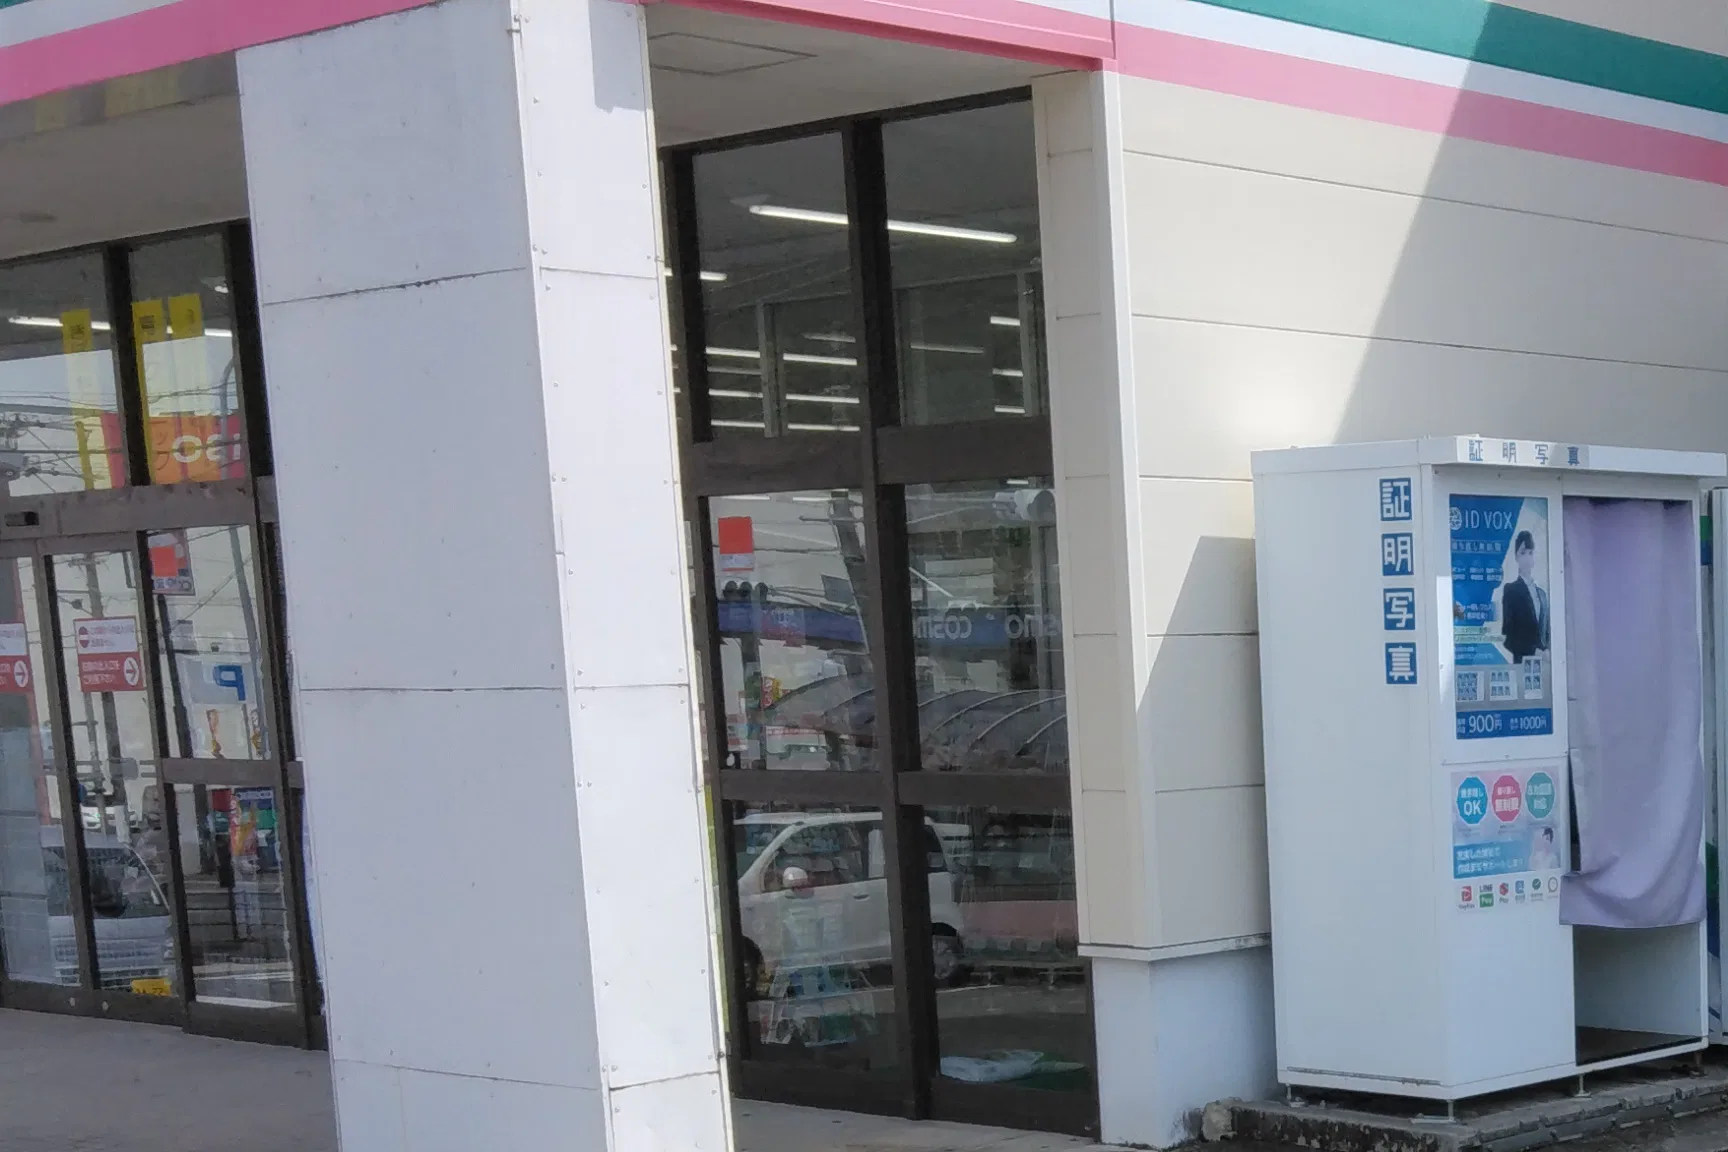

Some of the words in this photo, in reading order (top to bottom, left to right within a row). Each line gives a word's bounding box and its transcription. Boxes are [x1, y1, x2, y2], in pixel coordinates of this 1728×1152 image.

[1468, 440, 1580, 466] 証明写真
[1465, 509, 1480, 529] ID
[1484, 511, 1514, 530] VOX
[1382, 480, 1415, 681] 証明写真
[1463, 801, 1482, 816] OK
